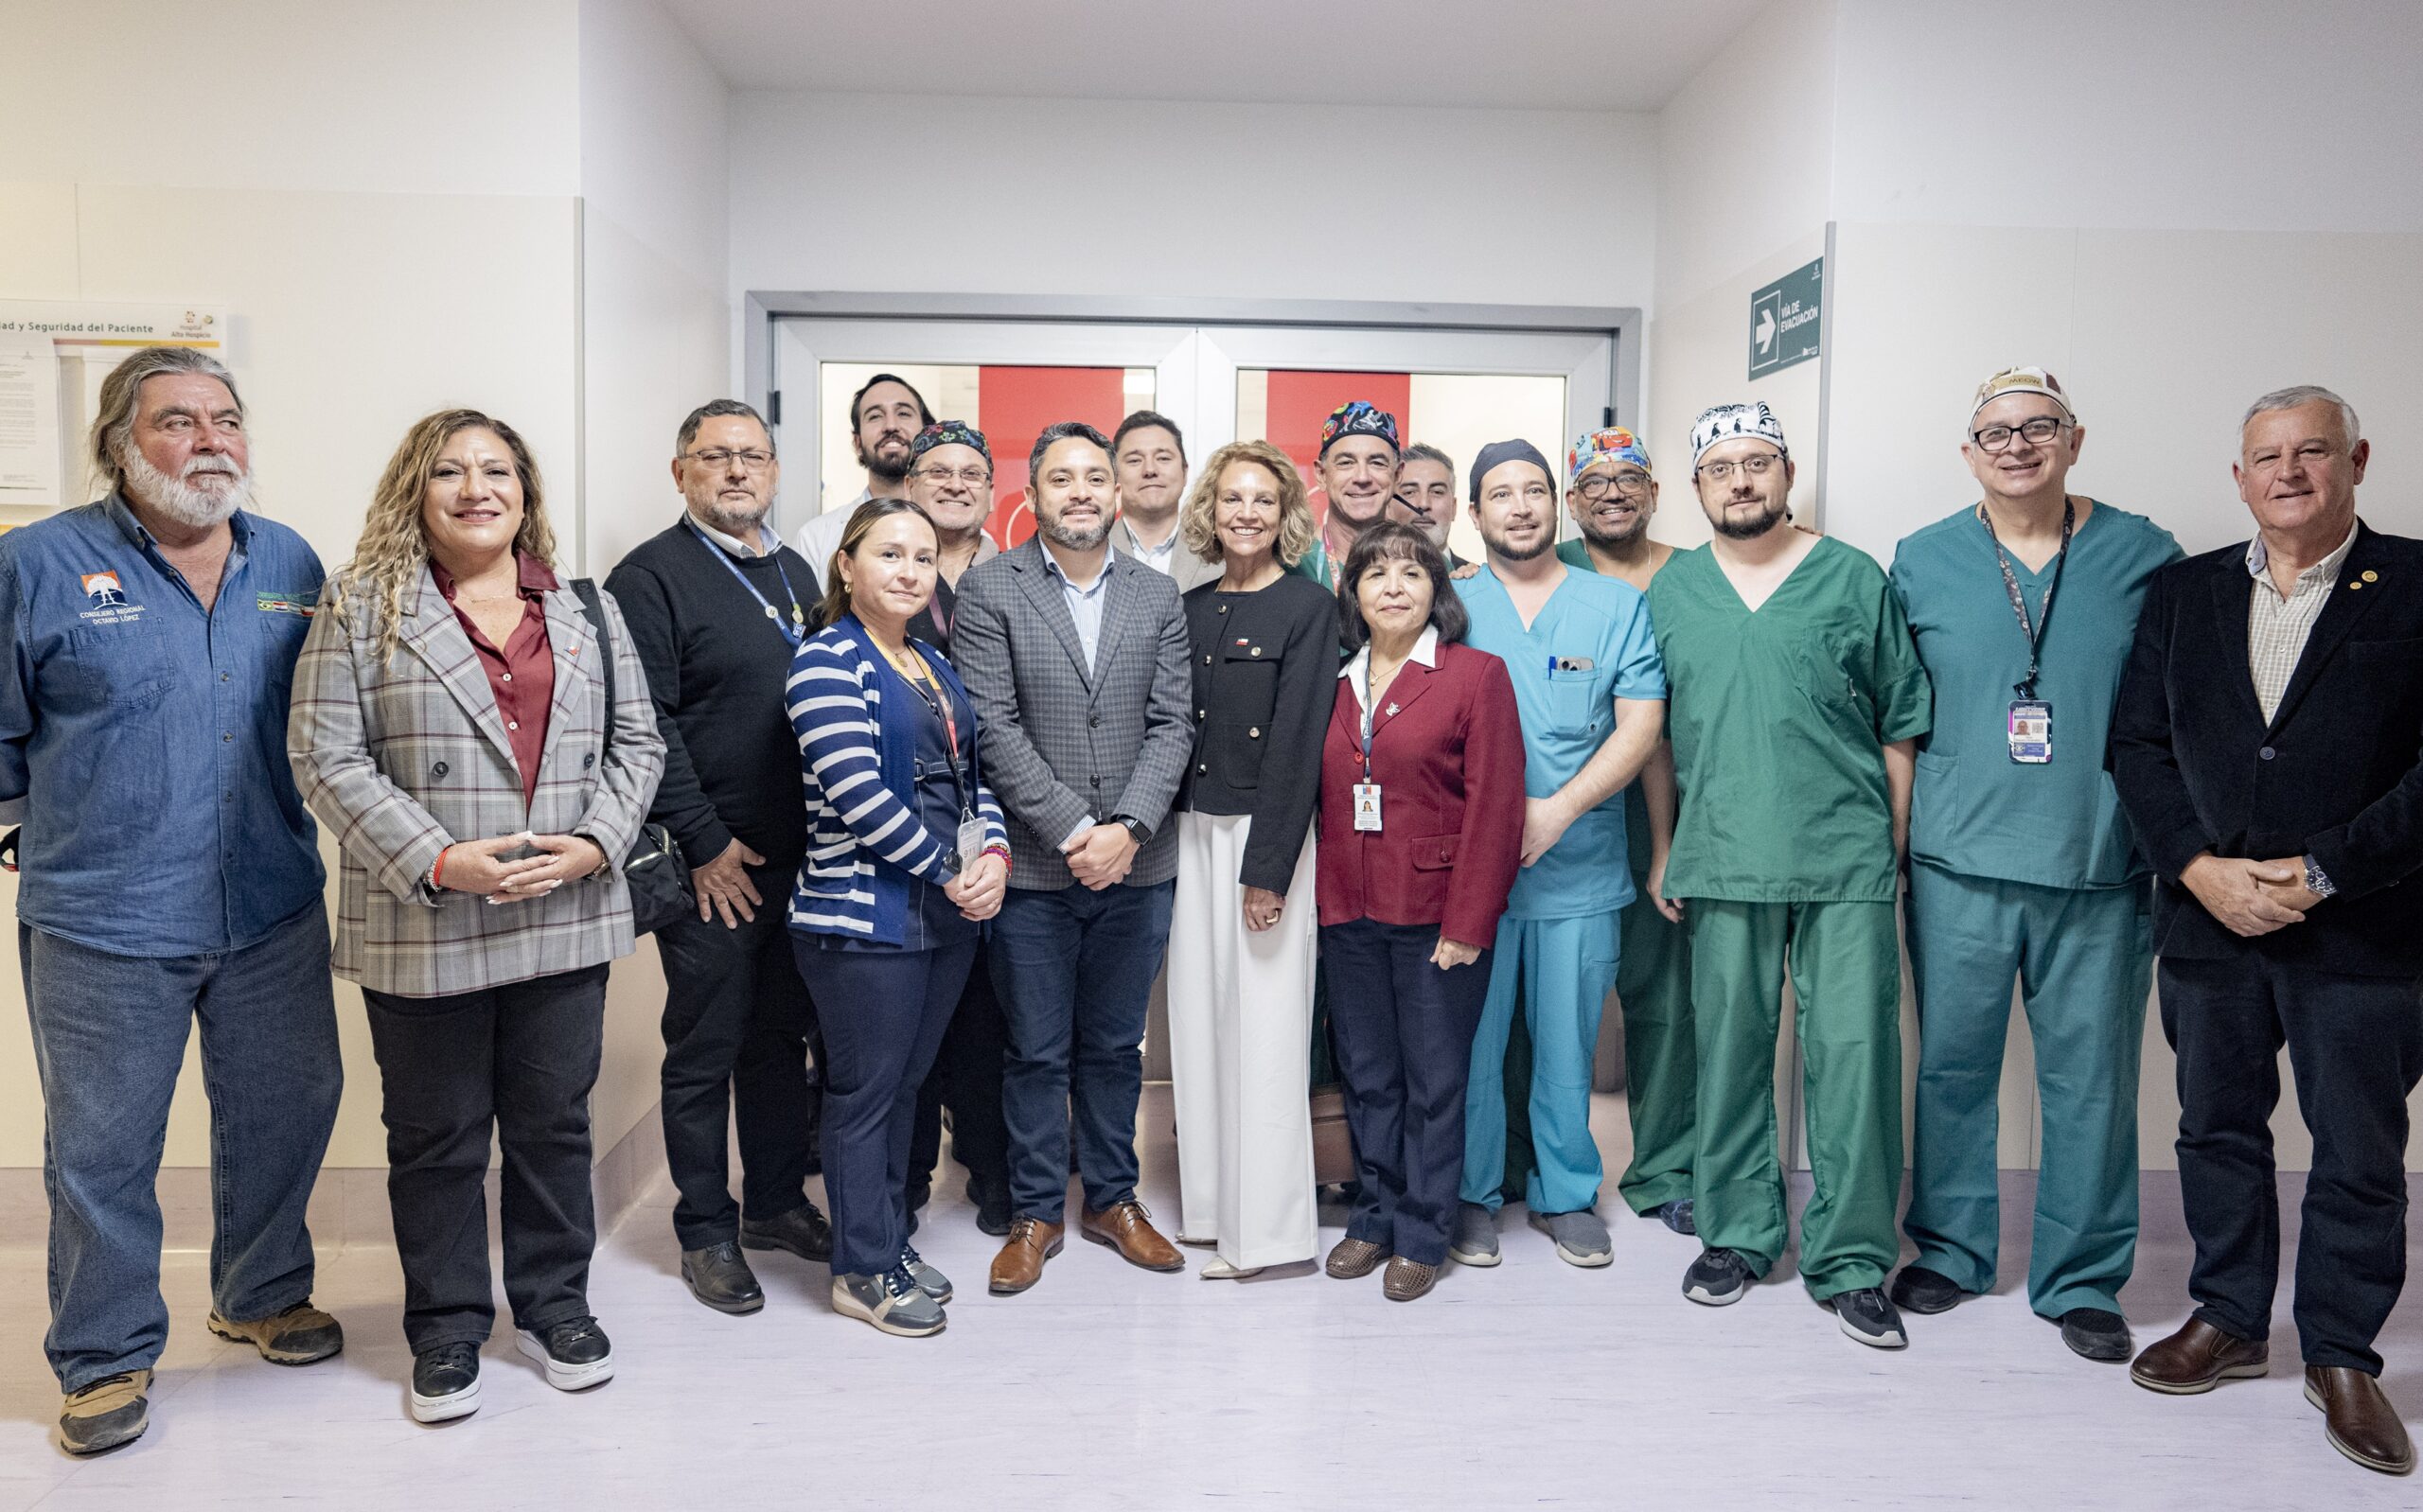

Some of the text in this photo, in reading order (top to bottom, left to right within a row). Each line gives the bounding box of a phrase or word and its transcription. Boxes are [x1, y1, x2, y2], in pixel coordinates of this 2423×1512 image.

[1781, 300, 1800, 319] VÍA DE
[1780, 305, 1818, 333] EVACUACIÓN
[18, 324, 25, 332] y
[28, 322, 83, 332] Seguridad
[87, 323, 104, 332] del
[107, 324, 153, 333] Paciente
[80, 605, 146, 619] CONSEJERO REGIONAL
